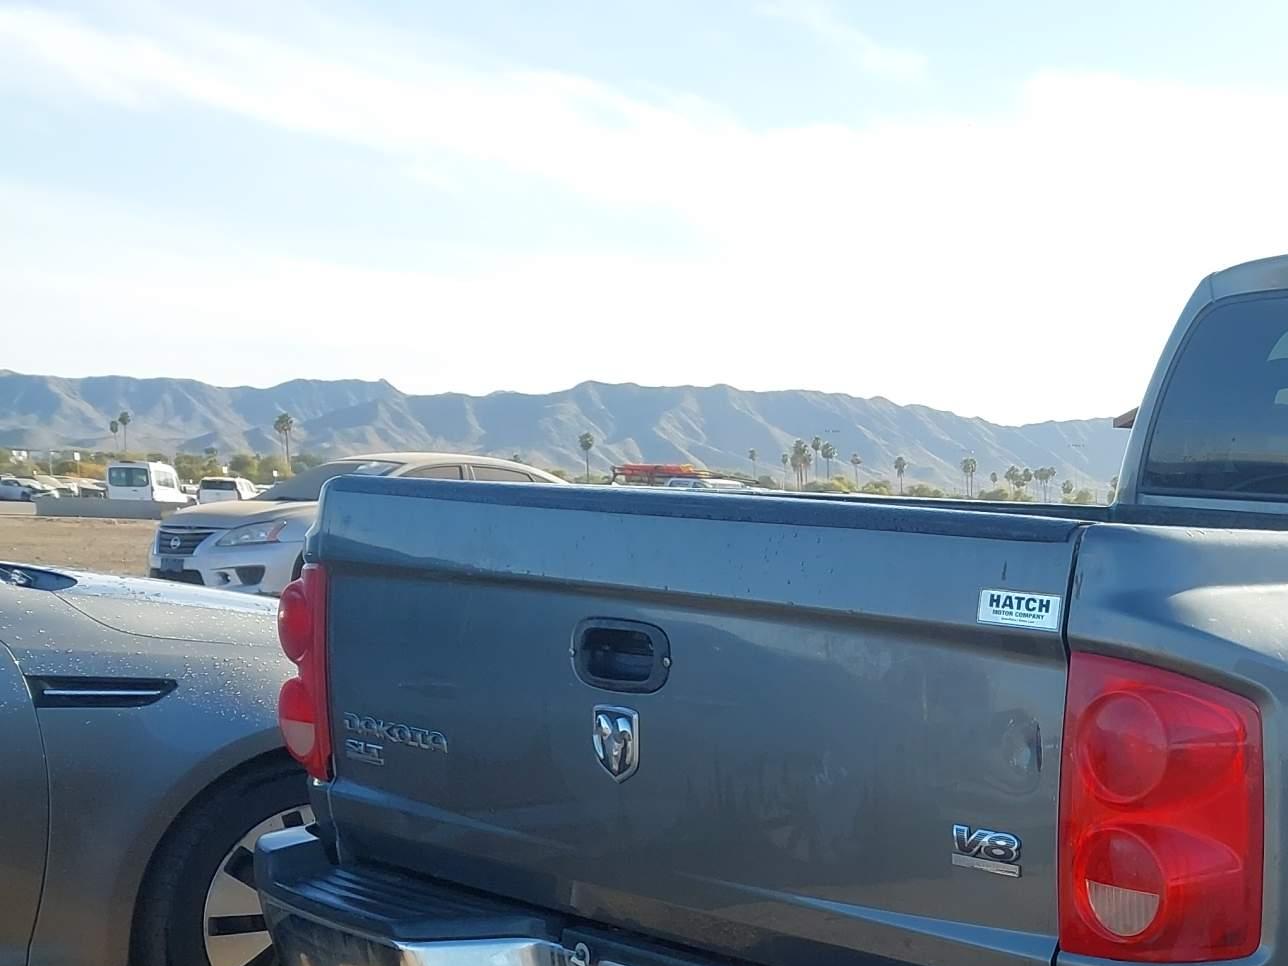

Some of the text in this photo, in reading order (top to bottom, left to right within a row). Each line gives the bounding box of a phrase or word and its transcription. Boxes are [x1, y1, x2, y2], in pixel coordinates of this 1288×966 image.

[989, 593, 1051, 613] HATCH
[992, 609, 1046, 620] MOTOR COMPANY
[343, 711, 448, 754] DAKOTA
[345, 739, 383, 760] SLT
[953, 824, 1021, 863] V8
